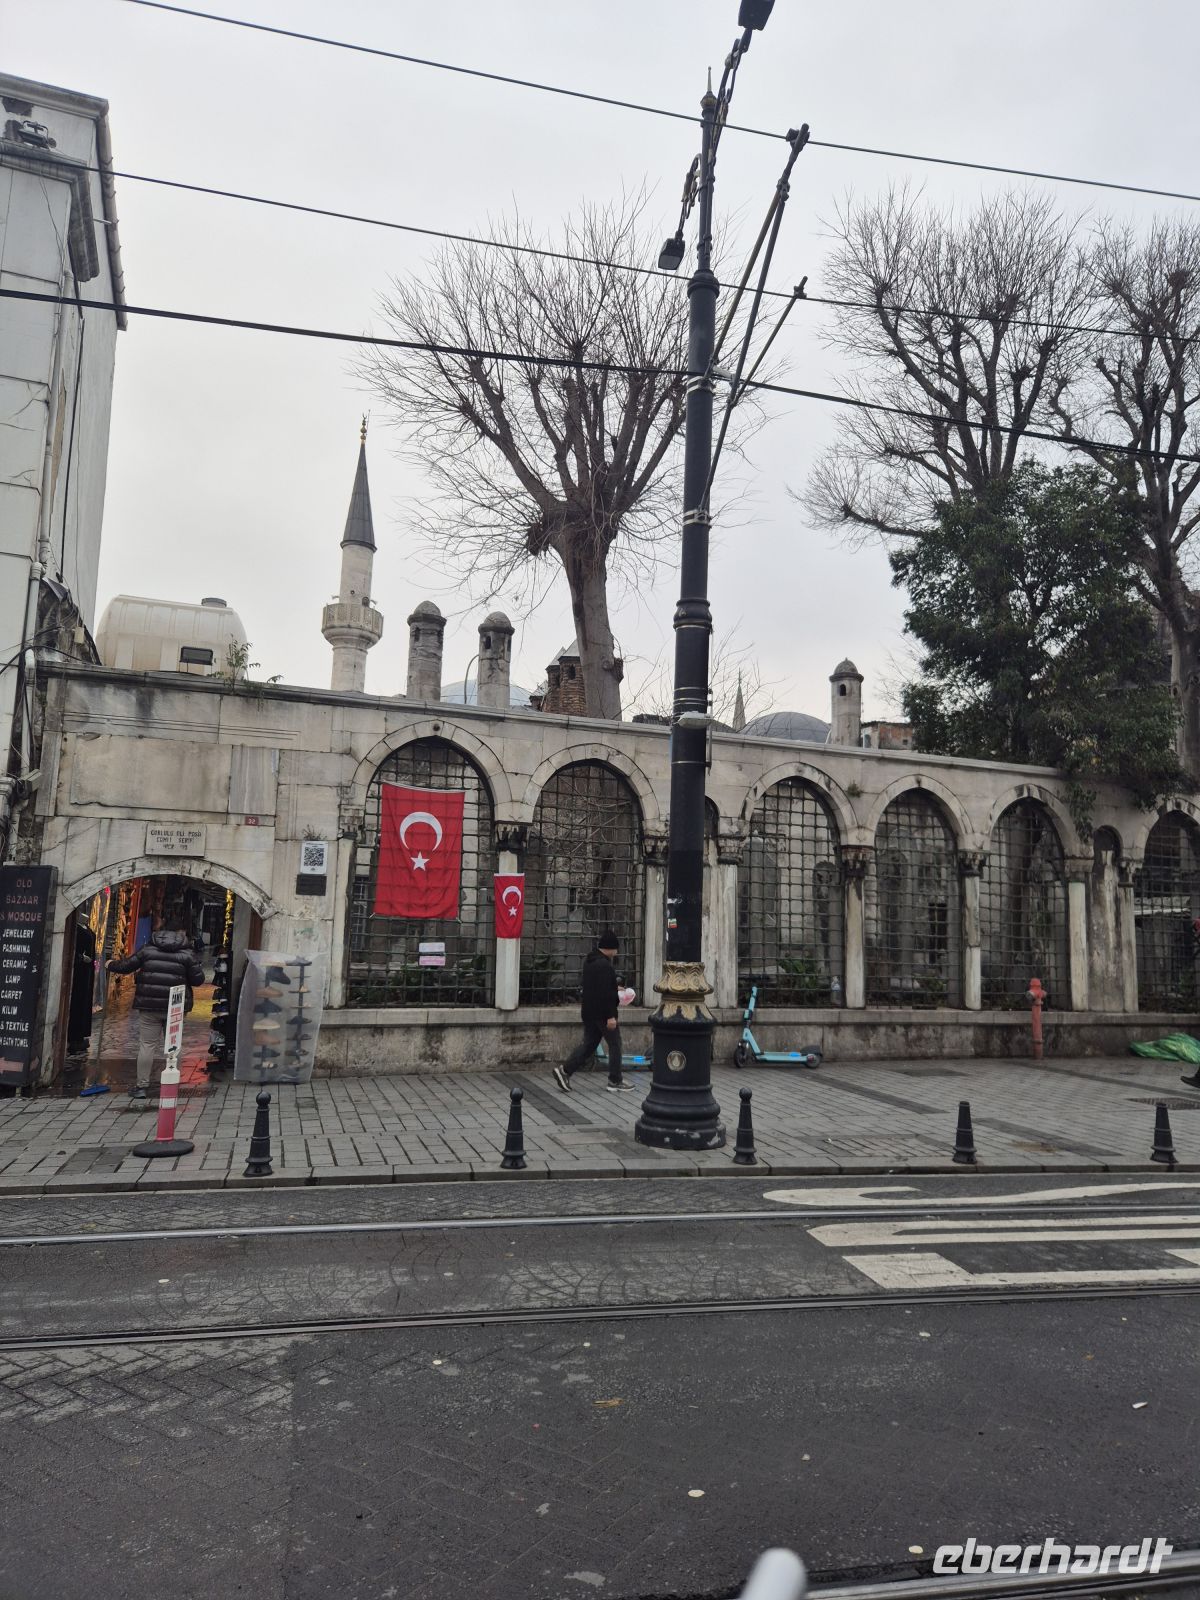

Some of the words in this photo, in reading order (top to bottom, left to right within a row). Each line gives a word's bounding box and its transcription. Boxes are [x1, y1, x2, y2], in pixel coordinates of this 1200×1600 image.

[16, 879, 32, 888] OLD
[6, 895, 39, 905] BAZAAR
[8, 911, 42, 922] MOSQUE
[3, 928, 35, 938] JEWELLERY
[2, 944, 31, 953] PASHMINA
[5, 975, 21, 984] LAMP
[0, 990, 23, 1000] CARPET
